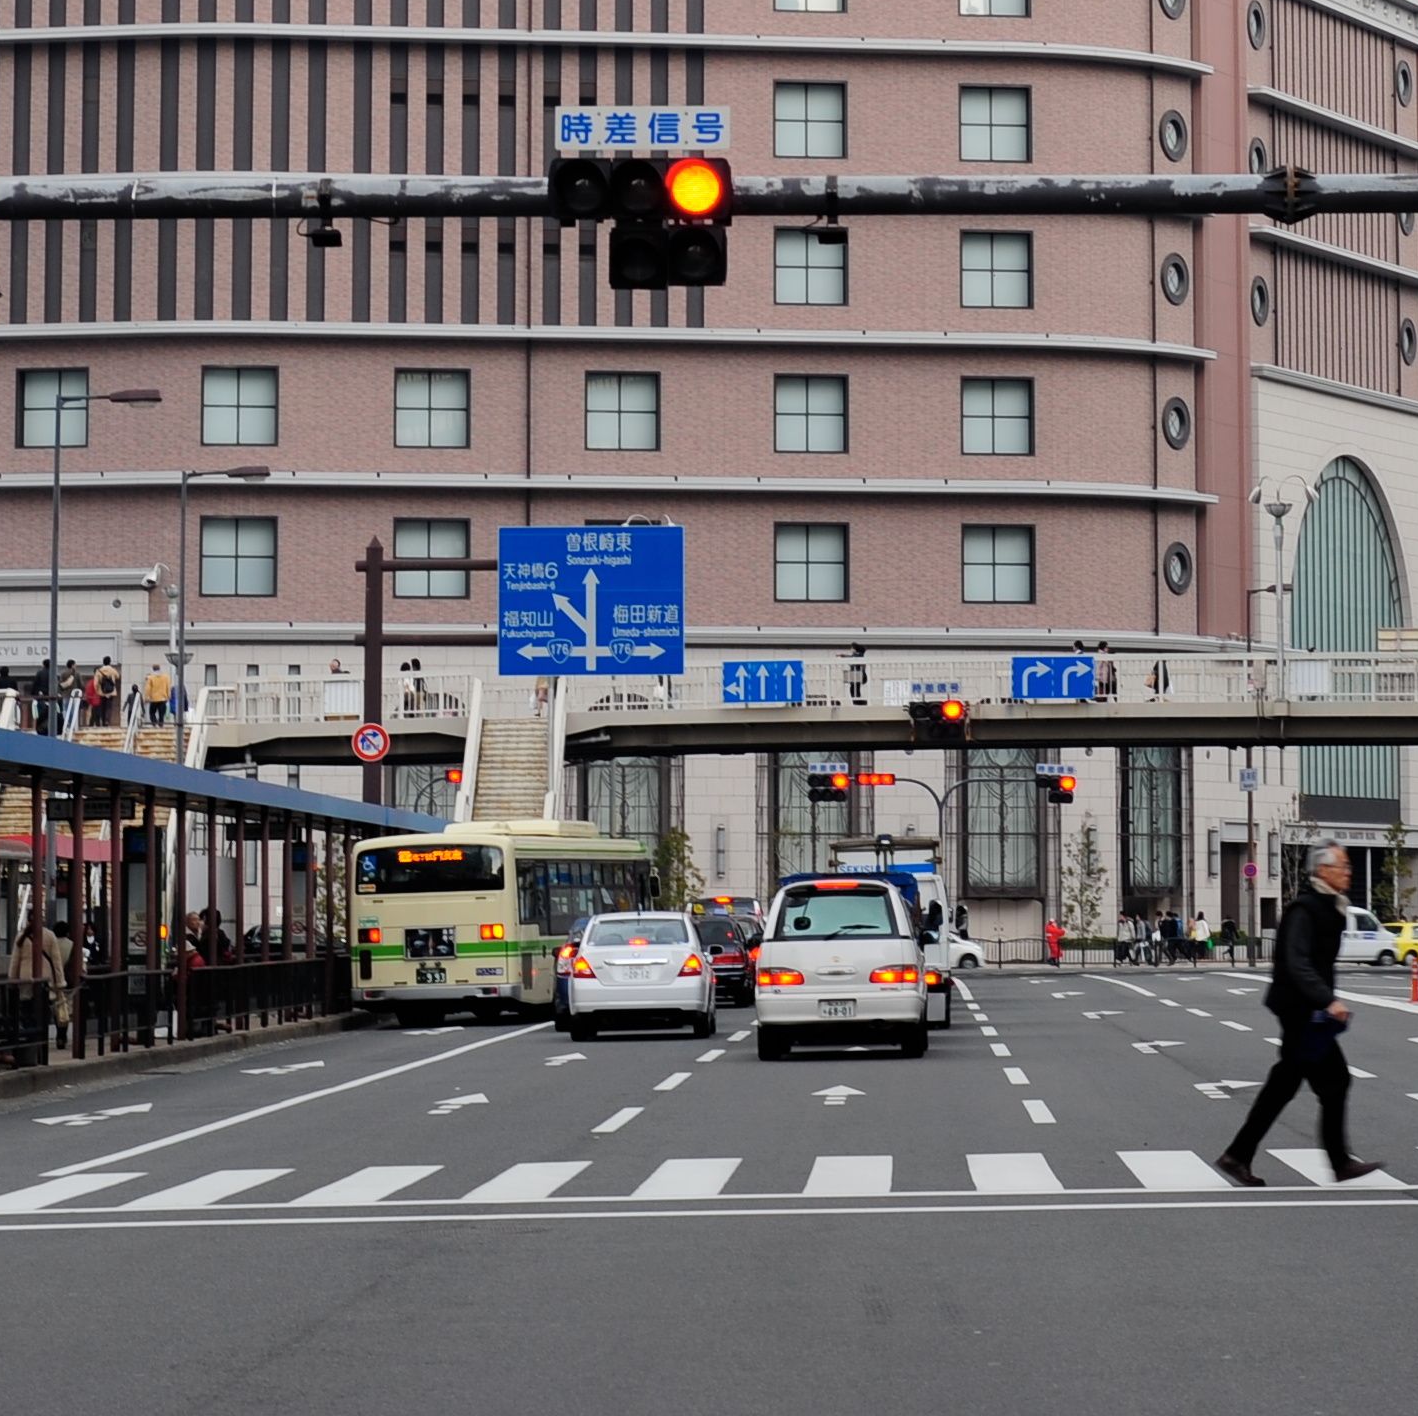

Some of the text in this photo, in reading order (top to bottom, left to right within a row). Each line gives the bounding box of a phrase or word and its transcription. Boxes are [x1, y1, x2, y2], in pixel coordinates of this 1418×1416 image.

[559, 111, 725, 146] 時差信号
[566, 554, 632, 566] Sonezaki-higashi
[503, 561, 559, 580] 天神橋6
[506, 581, 556, 591] Tenjinbashi-6
[503, 610, 554, 627] 福知山
[612, 604, 680, 624] 梅田新道
[501, 629, 555, 639] Fukuchiyama
[612, 626, 680, 638] Umeda-shinmichi
[551, 643, 569, 655] 176
[613, 642, 631, 655] 176
